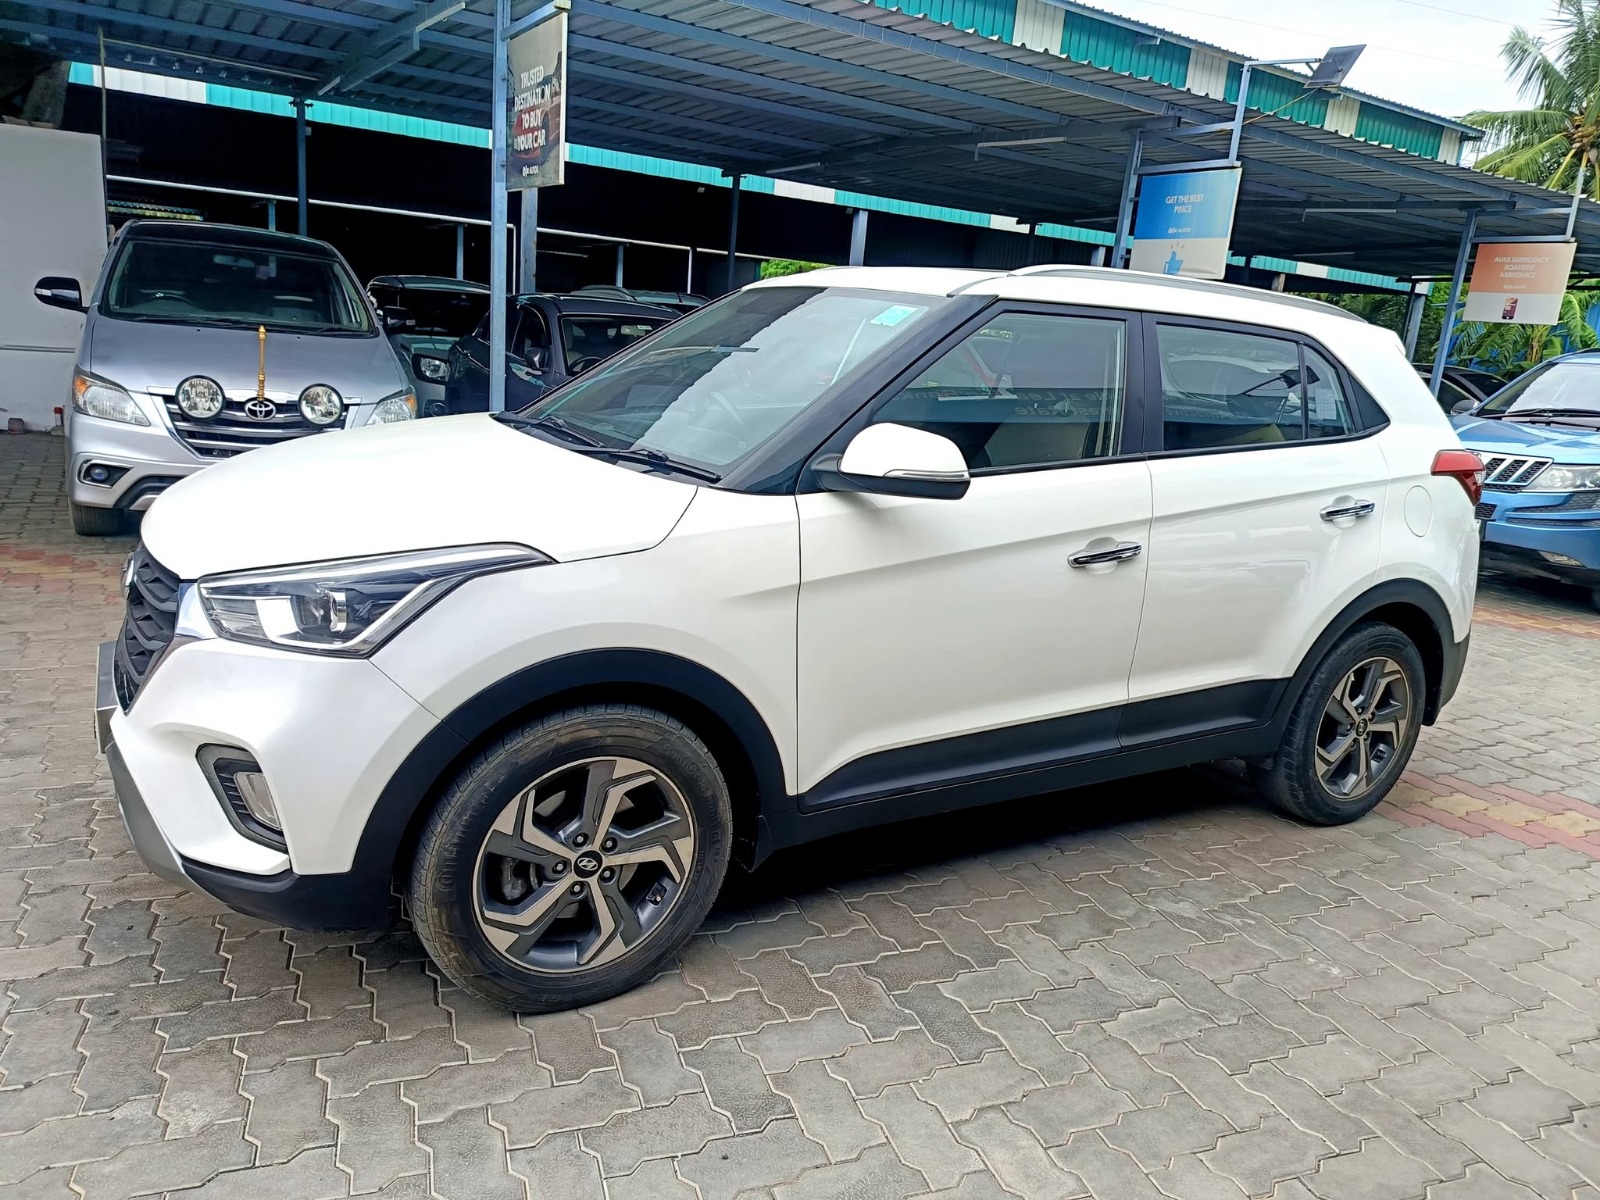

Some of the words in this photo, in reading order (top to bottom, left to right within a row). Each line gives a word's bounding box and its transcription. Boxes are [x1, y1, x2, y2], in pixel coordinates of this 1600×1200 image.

[521, 66, 544, 89] TRUSTED
[514, 83, 551, 112] DESTINATION
[522, 113, 530, 130] TO
[530, 109, 543, 127] BUY
[517, 132, 533, 151] YOUR
[533, 129, 546, 148] CAR
[1165, 195, 1177, 204] GET
[1178, 195, 1189, 203] THE
[1189, 193, 1205, 203] BEST
[1173, 205, 1192, 214] PRICE
